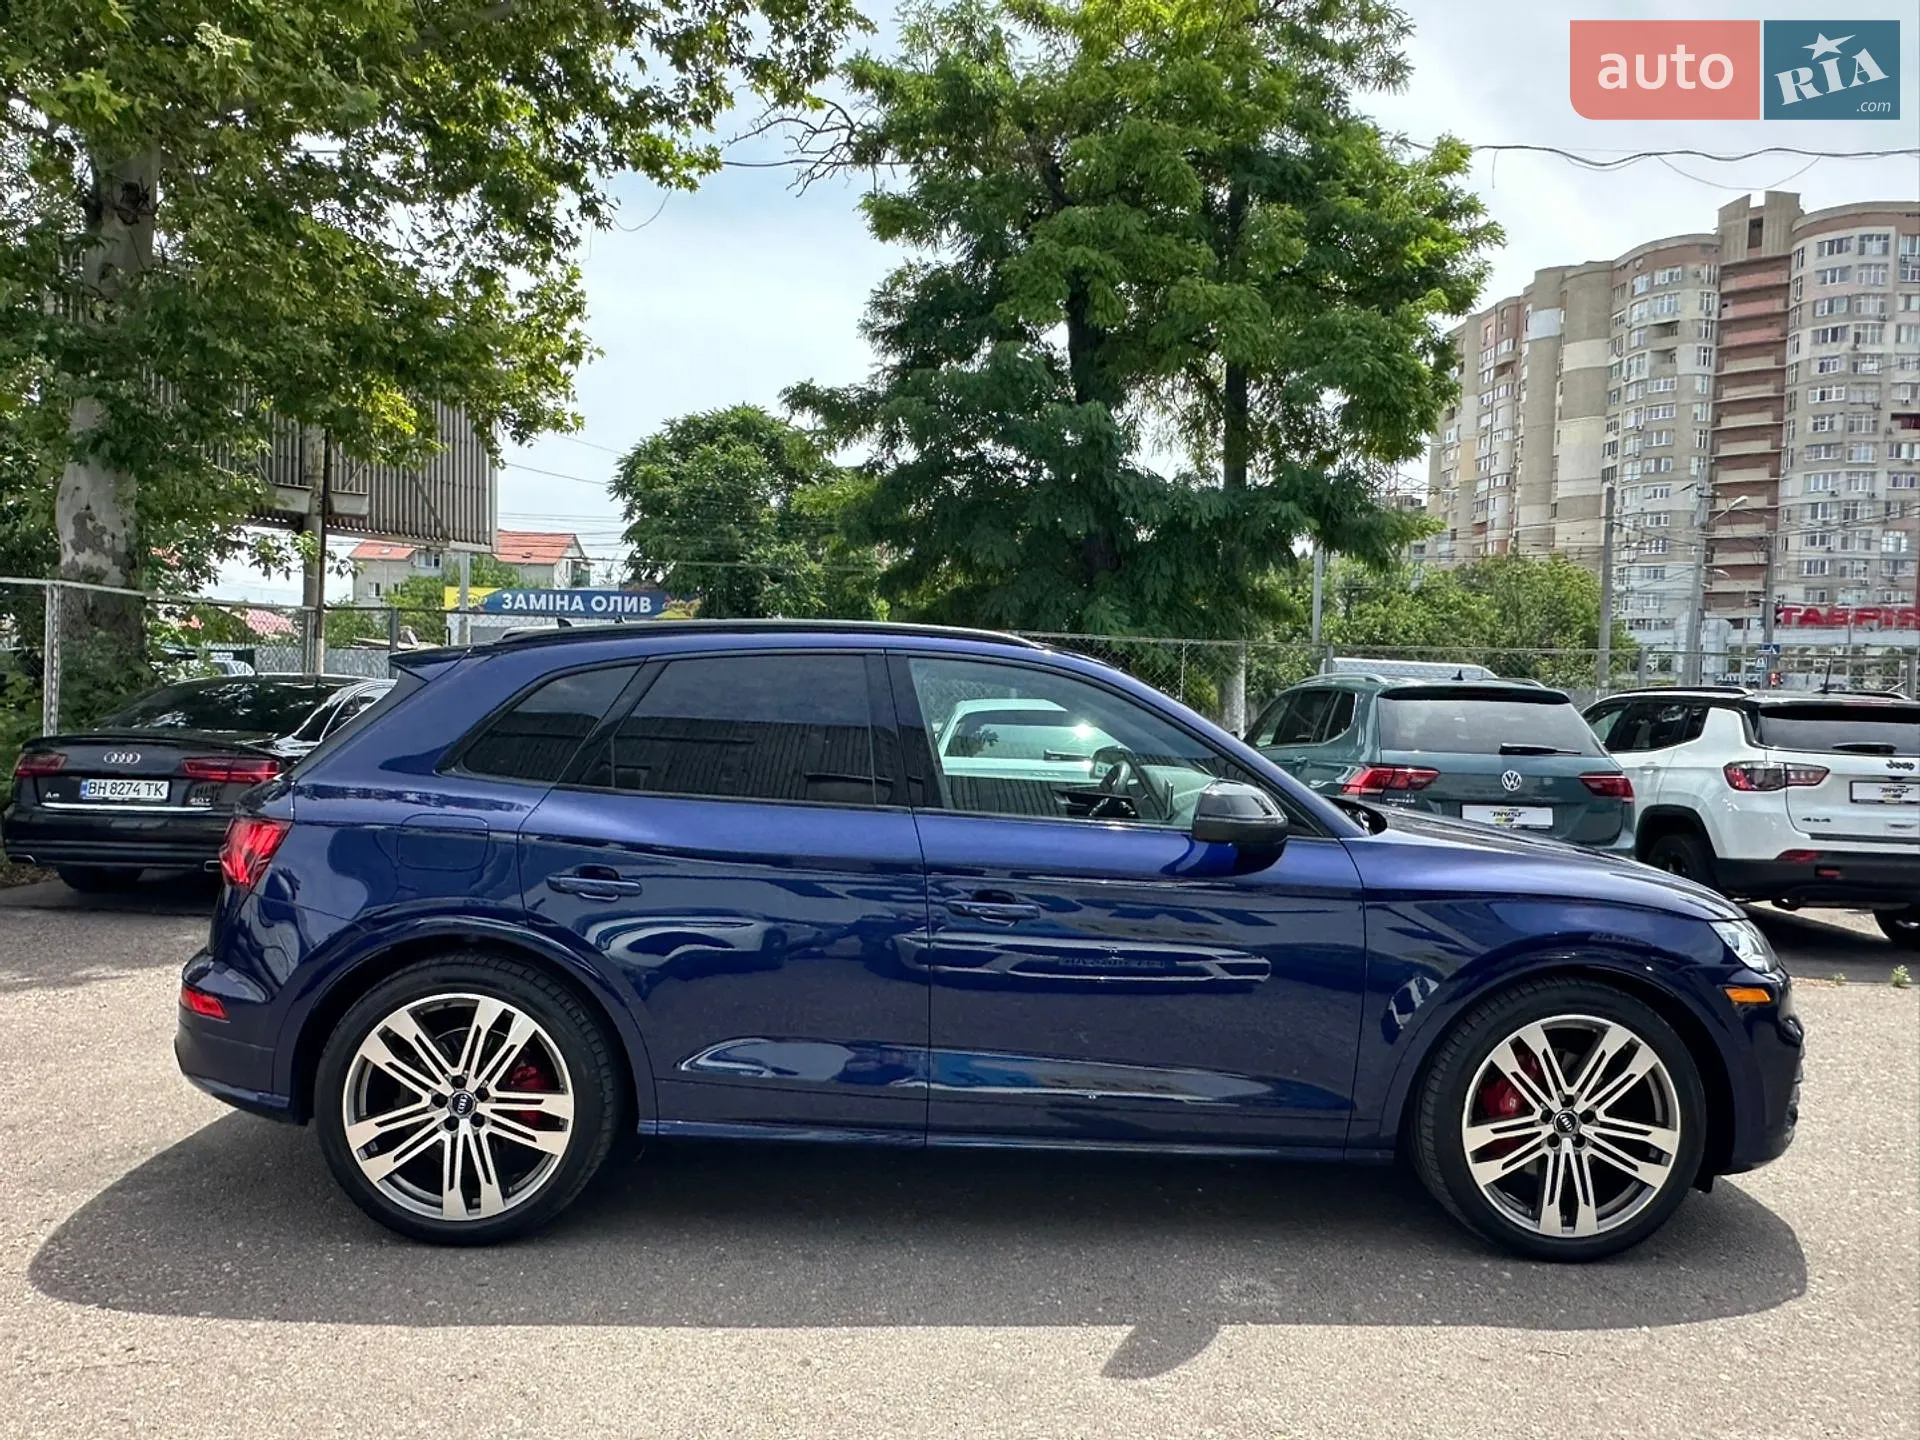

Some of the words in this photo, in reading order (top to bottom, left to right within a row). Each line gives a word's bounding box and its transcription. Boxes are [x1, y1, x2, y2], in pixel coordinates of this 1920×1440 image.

[501, 592, 585, 612] ЗАМІНА
[590, 595, 653, 614] ОЛИВ
[88, 781, 107, 795] BH
[109, 782, 141, 796] 8274
[144, 782, 164, 796] TK
